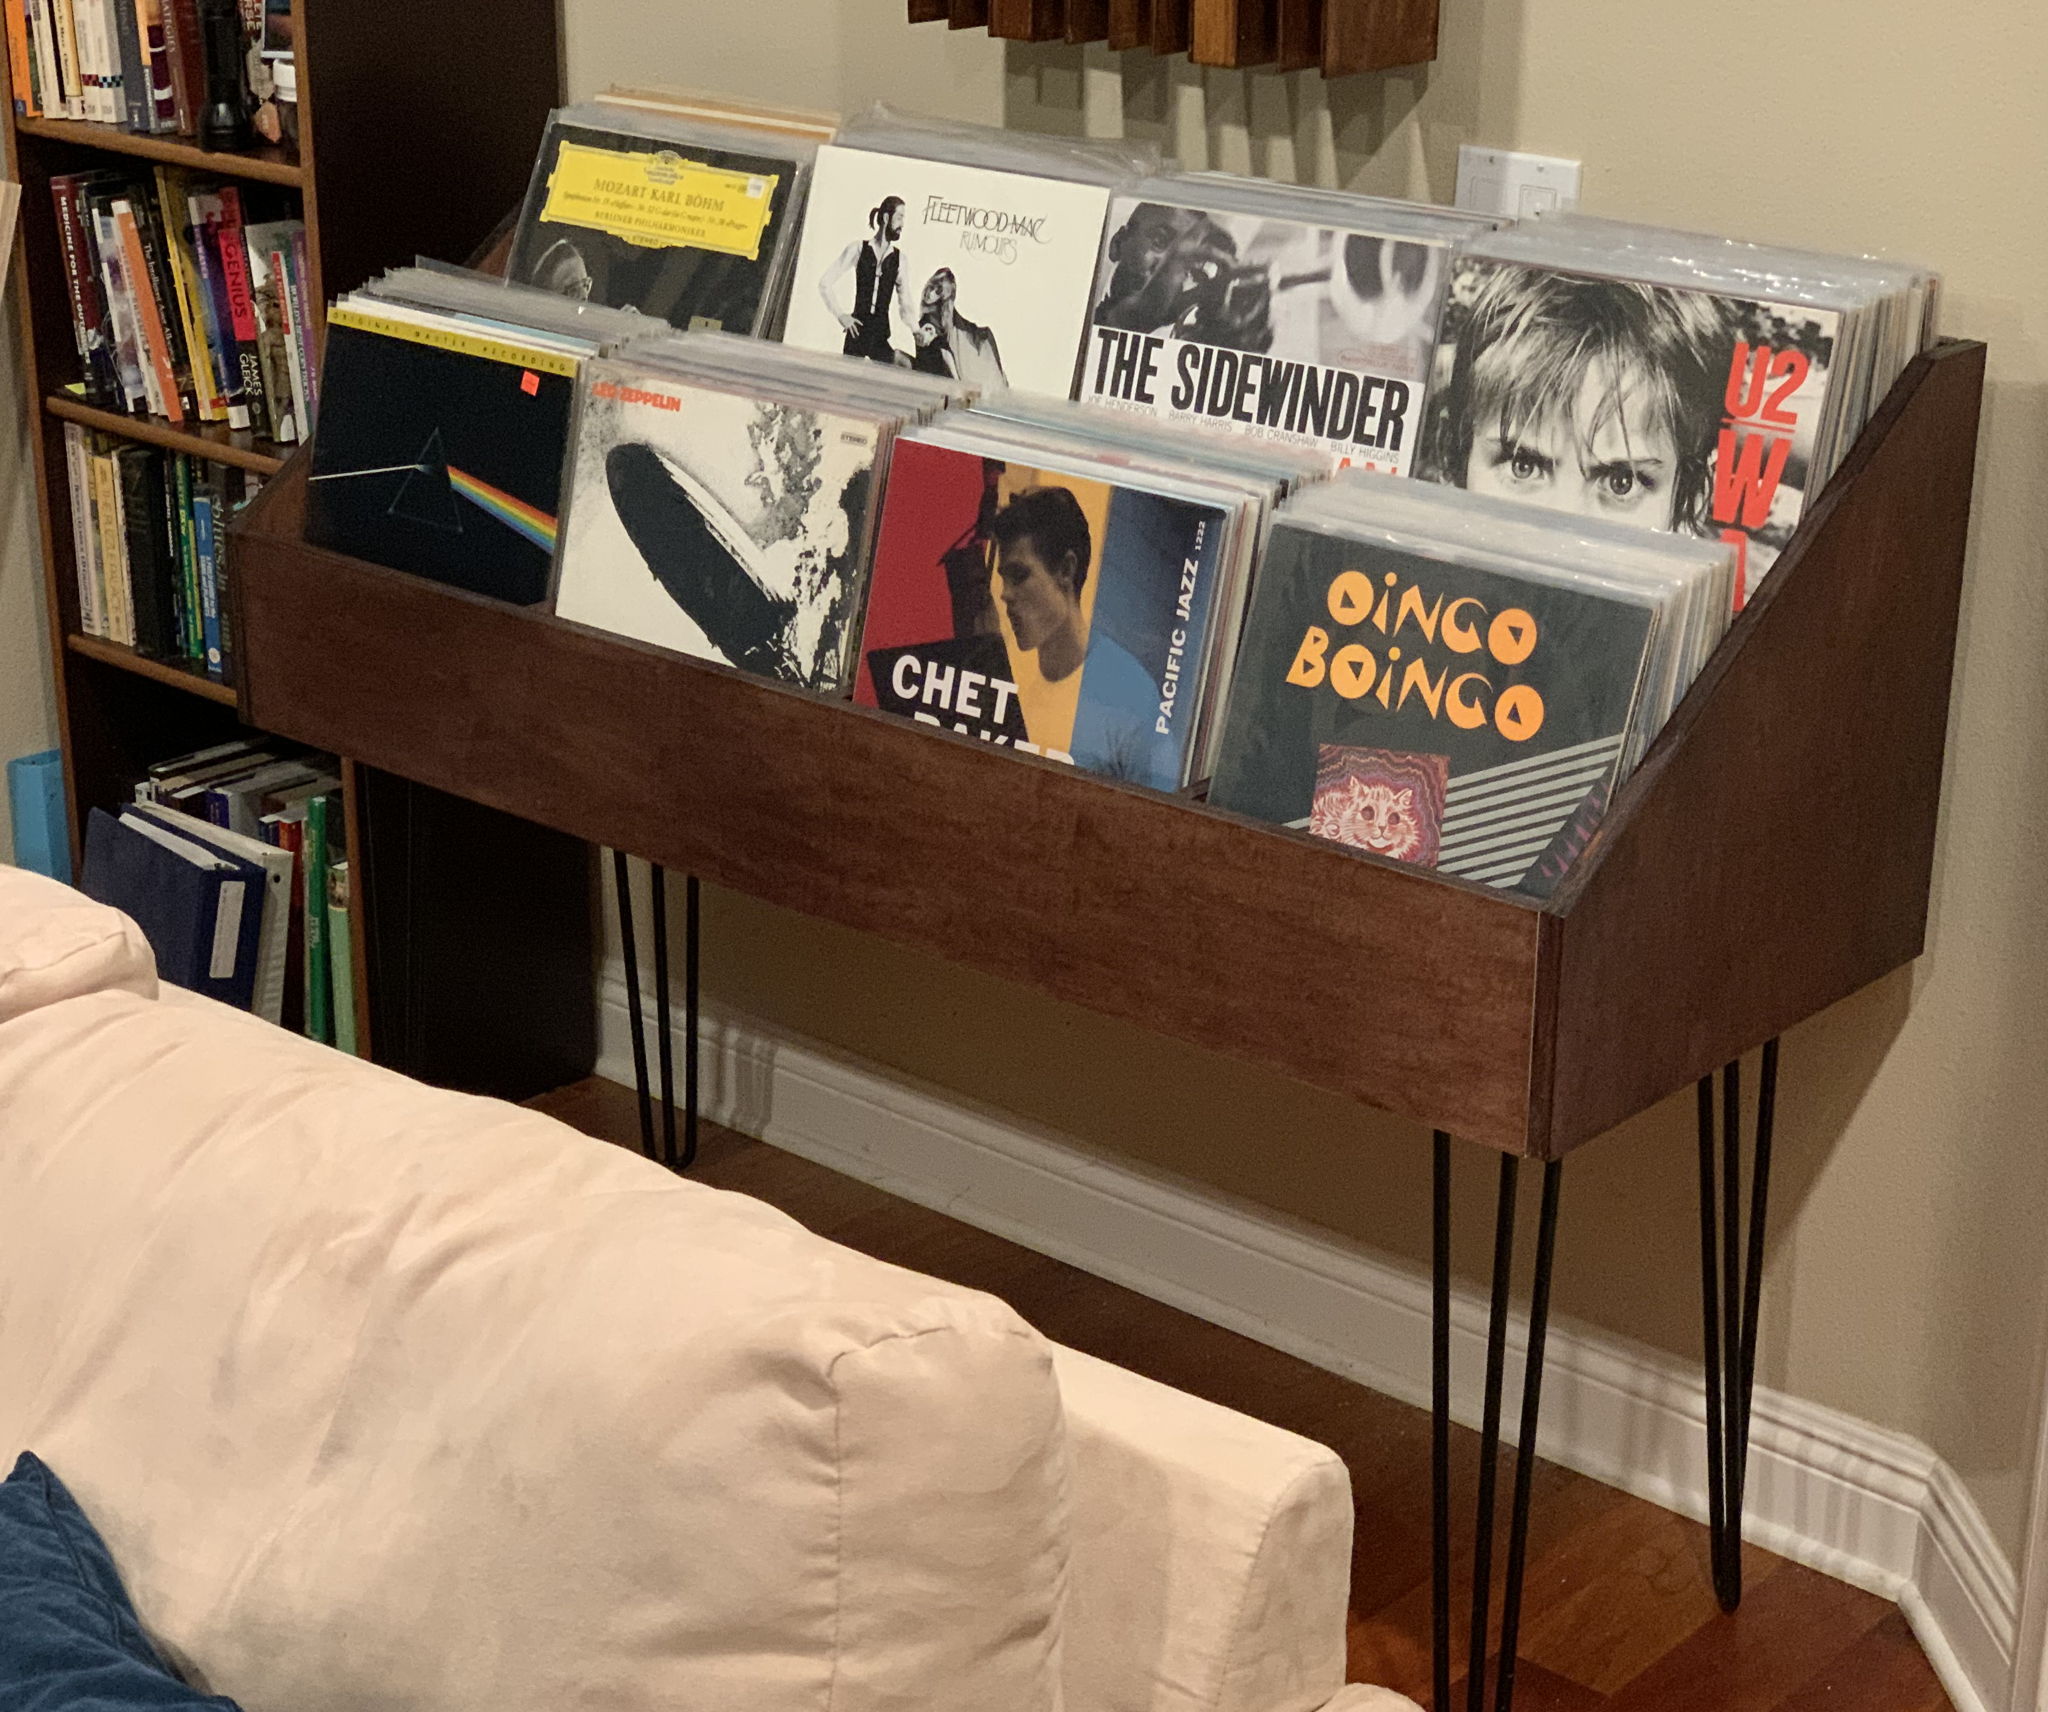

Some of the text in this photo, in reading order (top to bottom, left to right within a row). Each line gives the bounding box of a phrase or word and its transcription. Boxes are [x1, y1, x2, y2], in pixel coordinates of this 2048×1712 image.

[593, 178, 646, 199] MOZART
[650, 189, 682, 206] KARL
[685, 195, 725, 213] BÖHM
[60, 196, 74, 252] MEDICINE
[923, 195, 1053, 244] FLEETWOOD MAC
[69, 254, 78, 276] FOR
[959, 231, 1018, 265] RUMOURS
[73, 279, 82, 301] THE
[225, 243, 247, 318] GENIUS
[240, 353, 254, 396] GLEICK
[248, 355, 263, 396] JAMES
[591, 381, 682, 412] LED ZEPPELIN
[1094, 328, 1410, 452] THE SIDEWINDER
[1725, 342, 1811, 425] U2
[1104, 399, 1158, 417] HENDERSON
[1168, 410, 1197, 425] BARRY
[1200, 414, 1233, 433] HARRIS
[1244, 425, 1264, 439] BOB
[1266, 428, 1319, 448] CRANSHAW
[1330, 441, 1356, 456] BILLY
[1359, 446, 1400, 464] HIGGINS
[1194, 520, 1206, 551] 1222
[1155, 557, 1199, 735] PACIFIC JAZZ
[892, 654, 1019, 725] CHET
